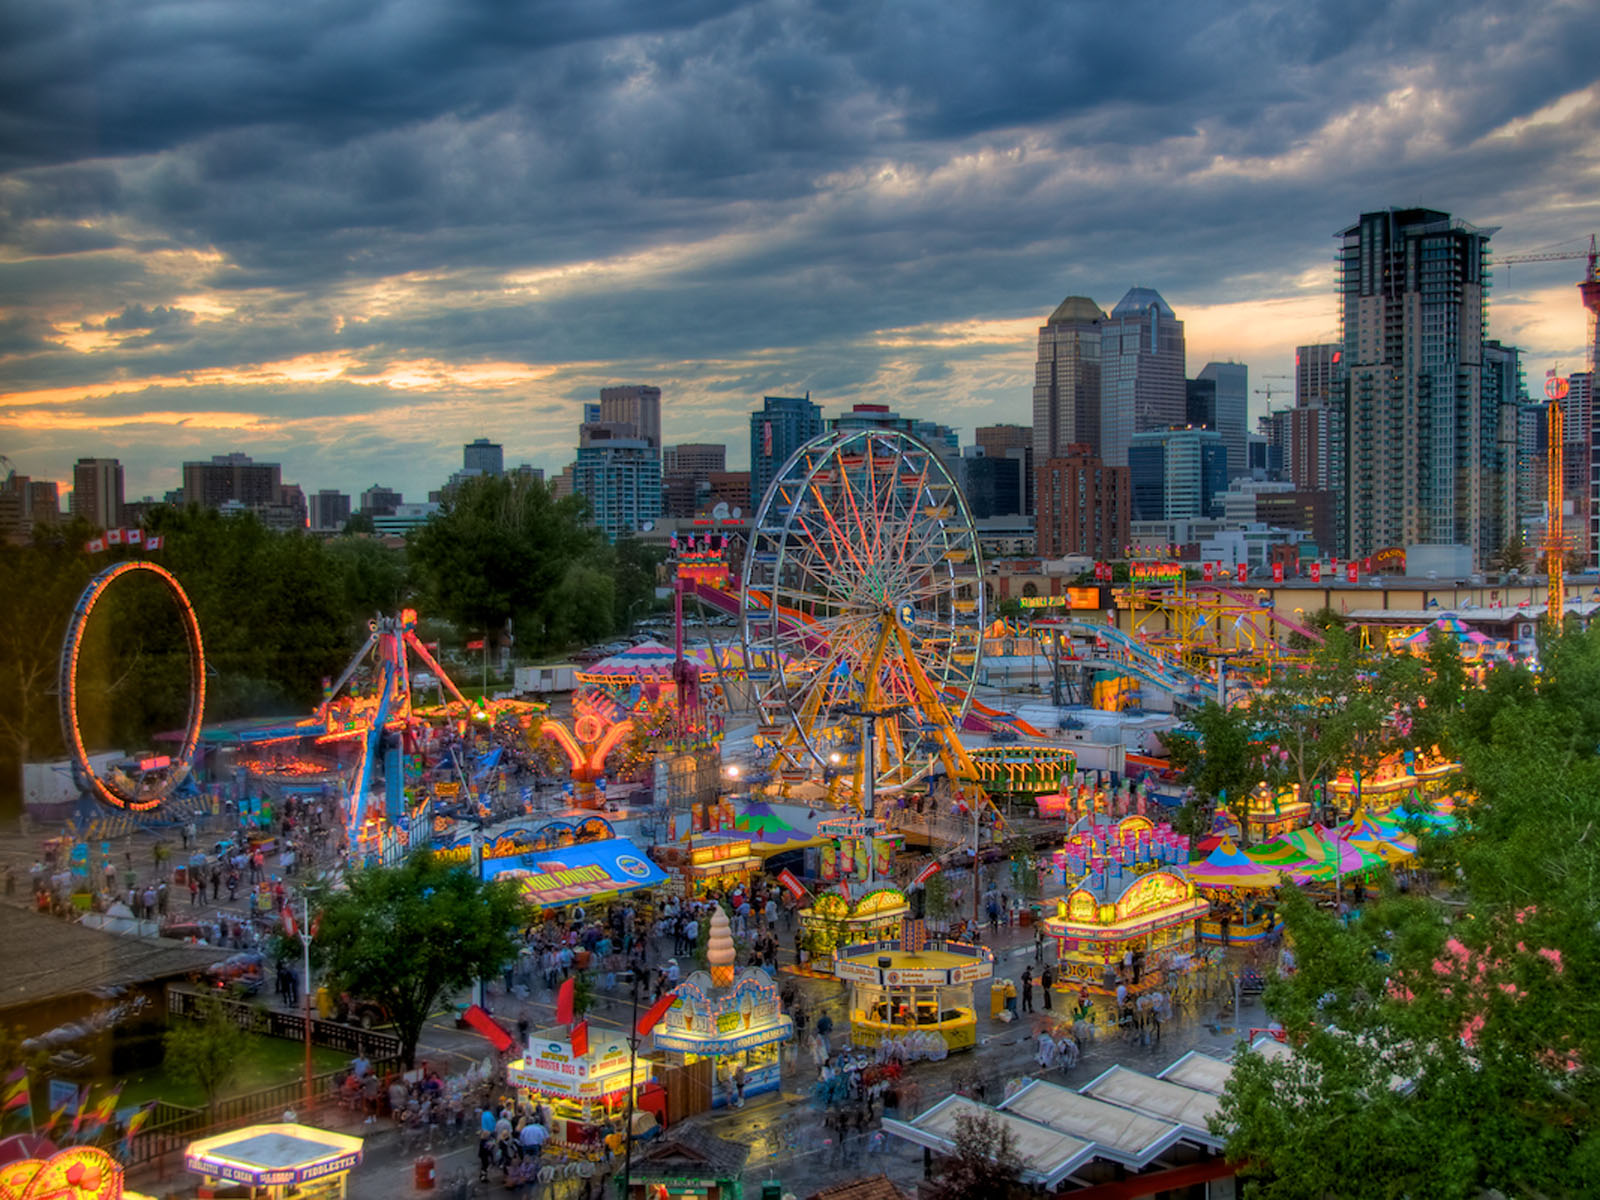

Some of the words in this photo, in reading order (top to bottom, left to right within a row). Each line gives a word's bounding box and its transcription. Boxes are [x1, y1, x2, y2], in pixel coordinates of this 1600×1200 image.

[554, 864, 610, 887] DONUTS
[535, 1058, 560, 1073] MONSTER
[561, 1063, 576, 1076] DOGS
[223, 1167, 233, 1178] ICE
[234, 1170, 254, 1183] CREAM
[302, 1155, 357, 1180] FIDDLESTIX
